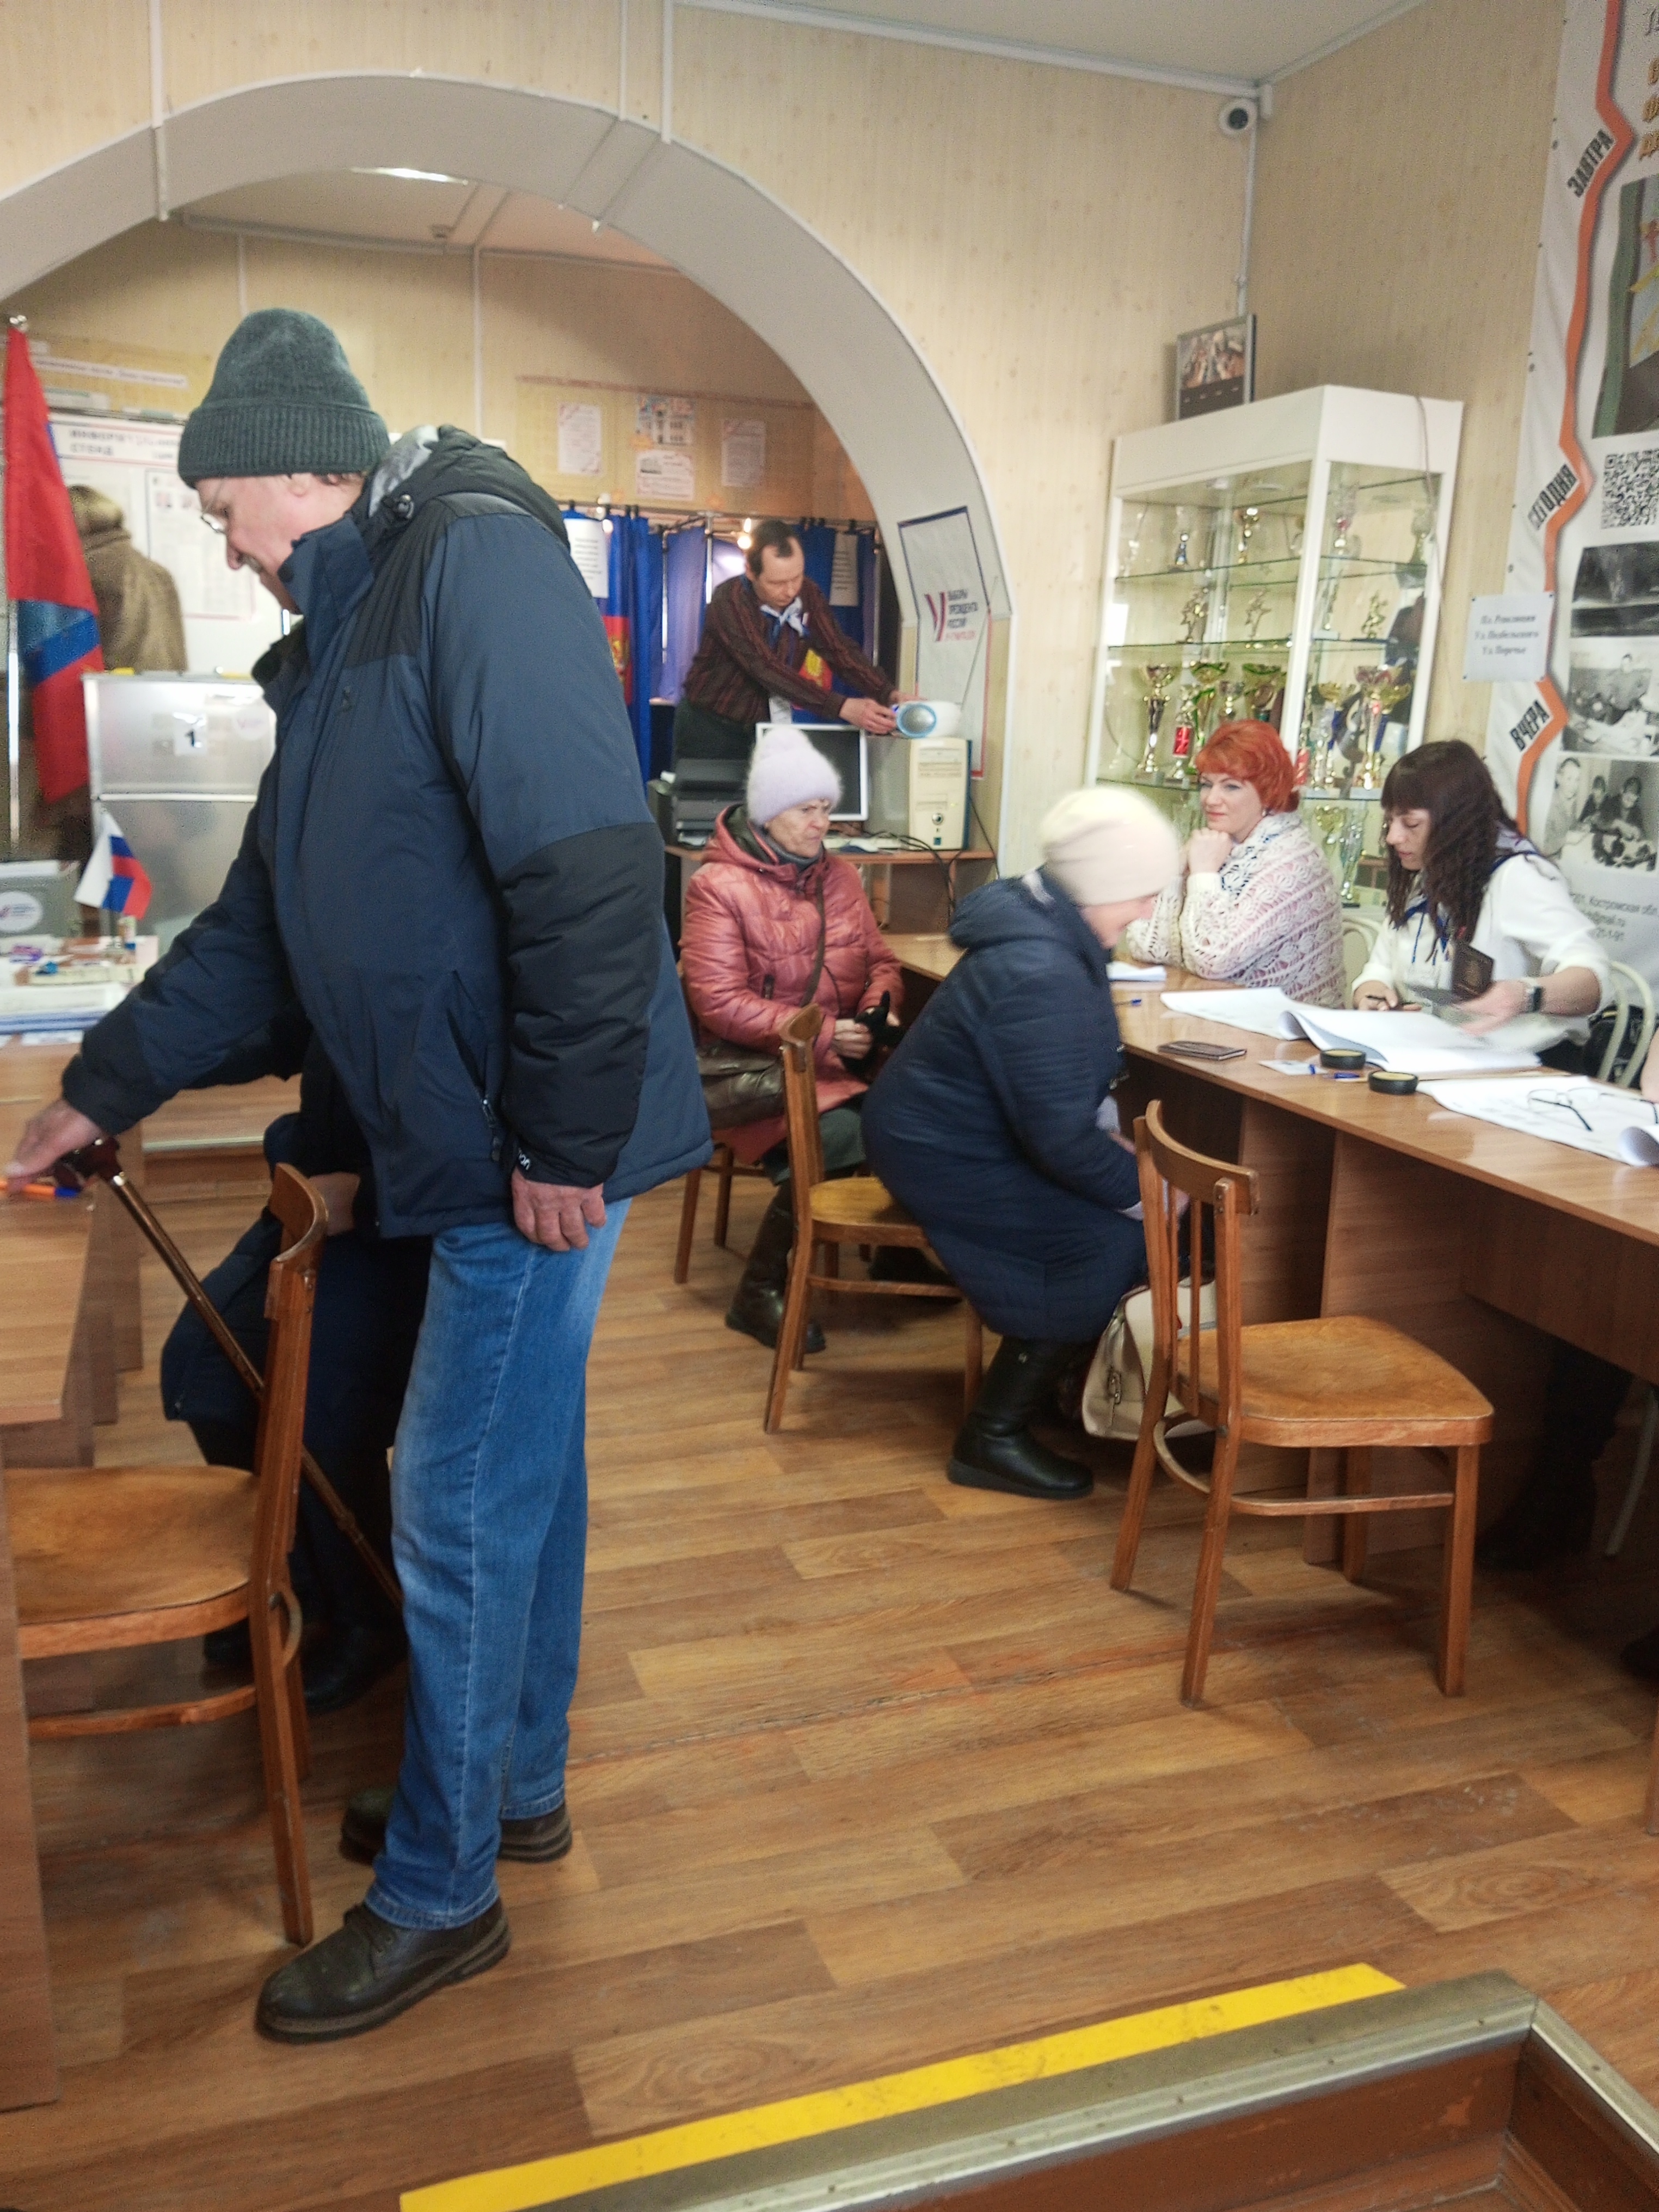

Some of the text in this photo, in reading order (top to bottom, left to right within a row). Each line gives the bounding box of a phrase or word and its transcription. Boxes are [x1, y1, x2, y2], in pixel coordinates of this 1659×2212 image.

[1568, 130, 1614, 197] ЗАВТРА
[185, 729, 194, 747] 1
[1509, 700, 1550, 751] ВЧЕРА
